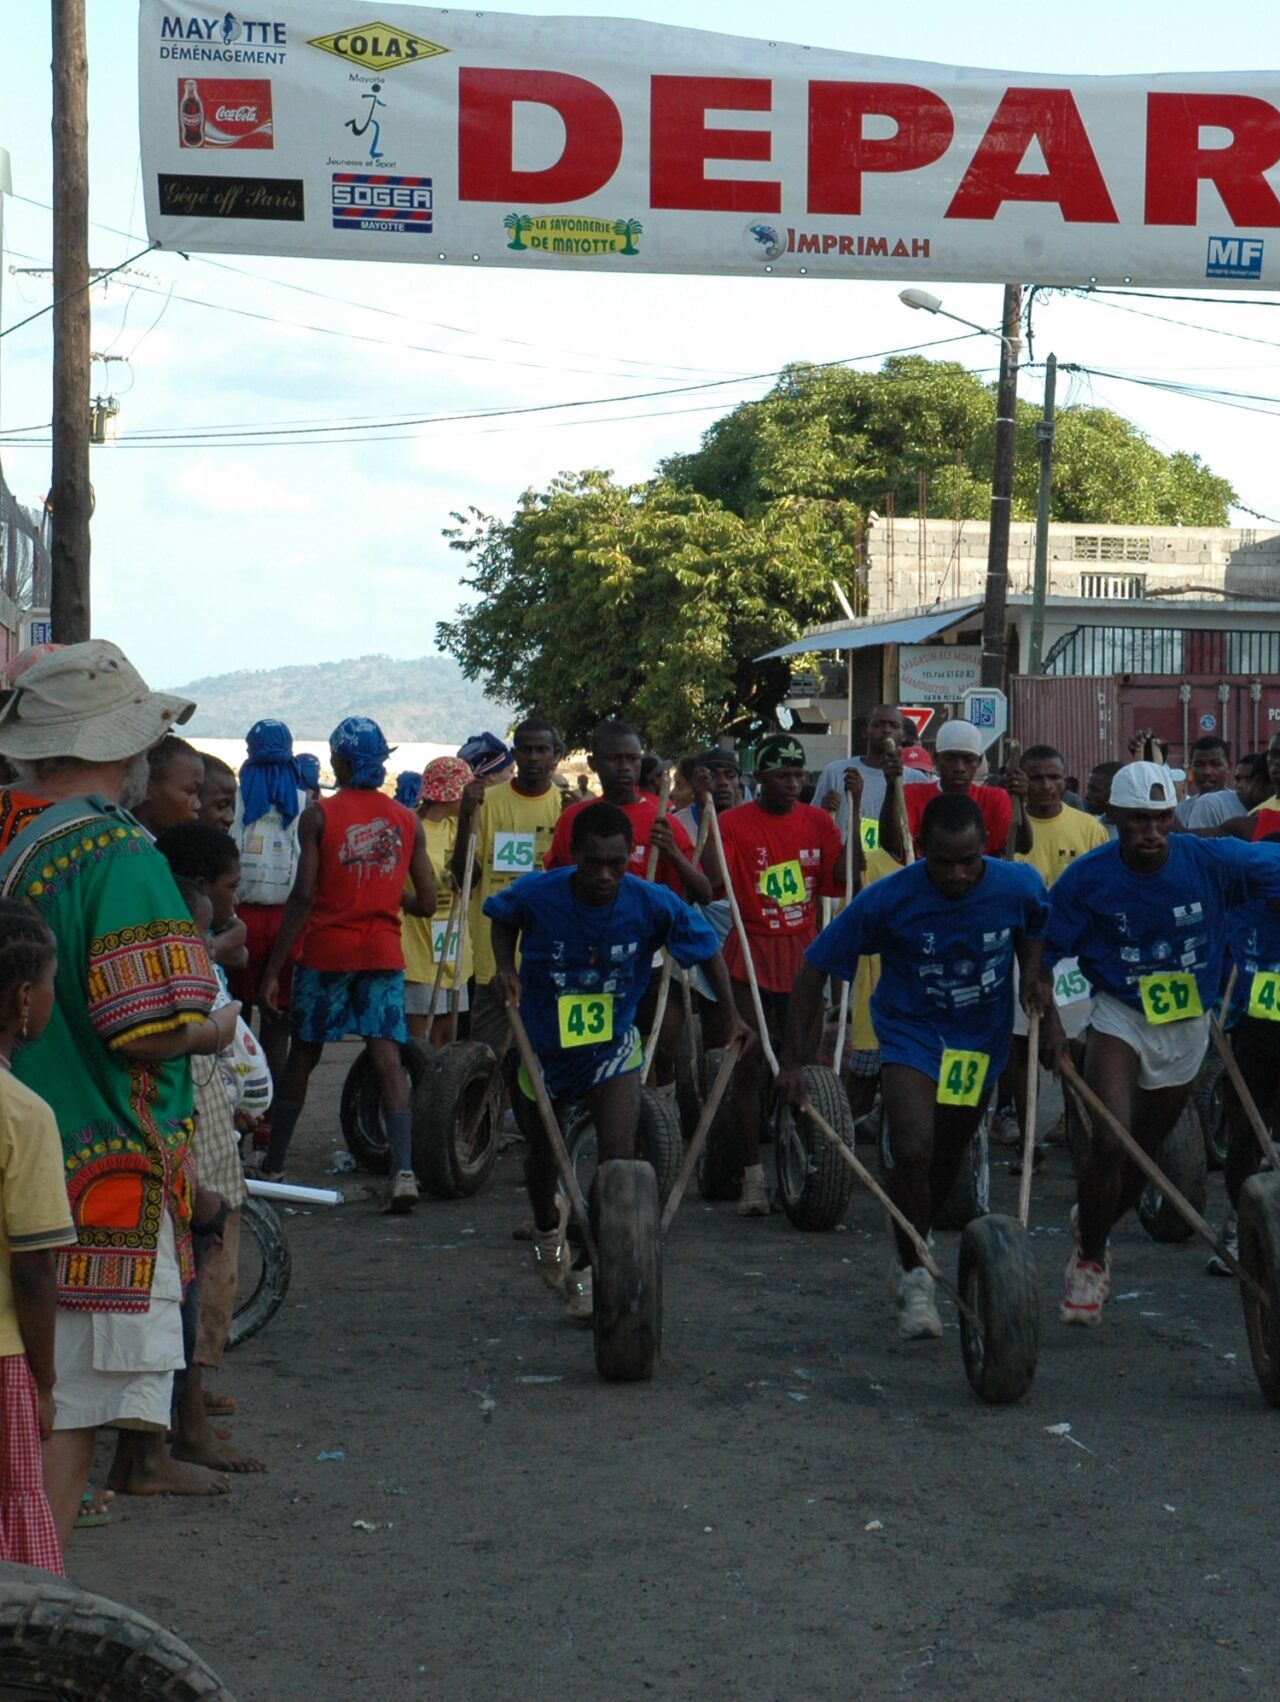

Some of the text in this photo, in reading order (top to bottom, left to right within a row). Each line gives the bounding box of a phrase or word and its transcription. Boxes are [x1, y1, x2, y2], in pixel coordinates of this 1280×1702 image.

[159, 46, 286, 65] DÉMÉNAGEMENT
[333, 34, 419, 59] COLAS
[349, 72, 386, 86] Mayotte
[326, 157, 397, 171] Jeunesse et Sport
[245, 186, 298, 209] Paris
[333, 185, 432, 208] SOGEA
[360, 221, 406, 232] MAYOTTE
[535, 218, 611, 233] LA SAYONNERIE
[531, 235, 617, 253] DE MAYOTTE
[786, 227, 931, 259] IMPRIMAH
[1208, 239, 1263, 267] MF
[496, 840, 534, 866] 45
[766, 867, 799, 899] 44
[434, 932, 458, 957] 47
[1054, 969, 1088, 998] 45
[1148, 979, 1189, 1016] 43
[567, 1001, 605, 1037] 43
[946, 1059, 978, 1096] 43
